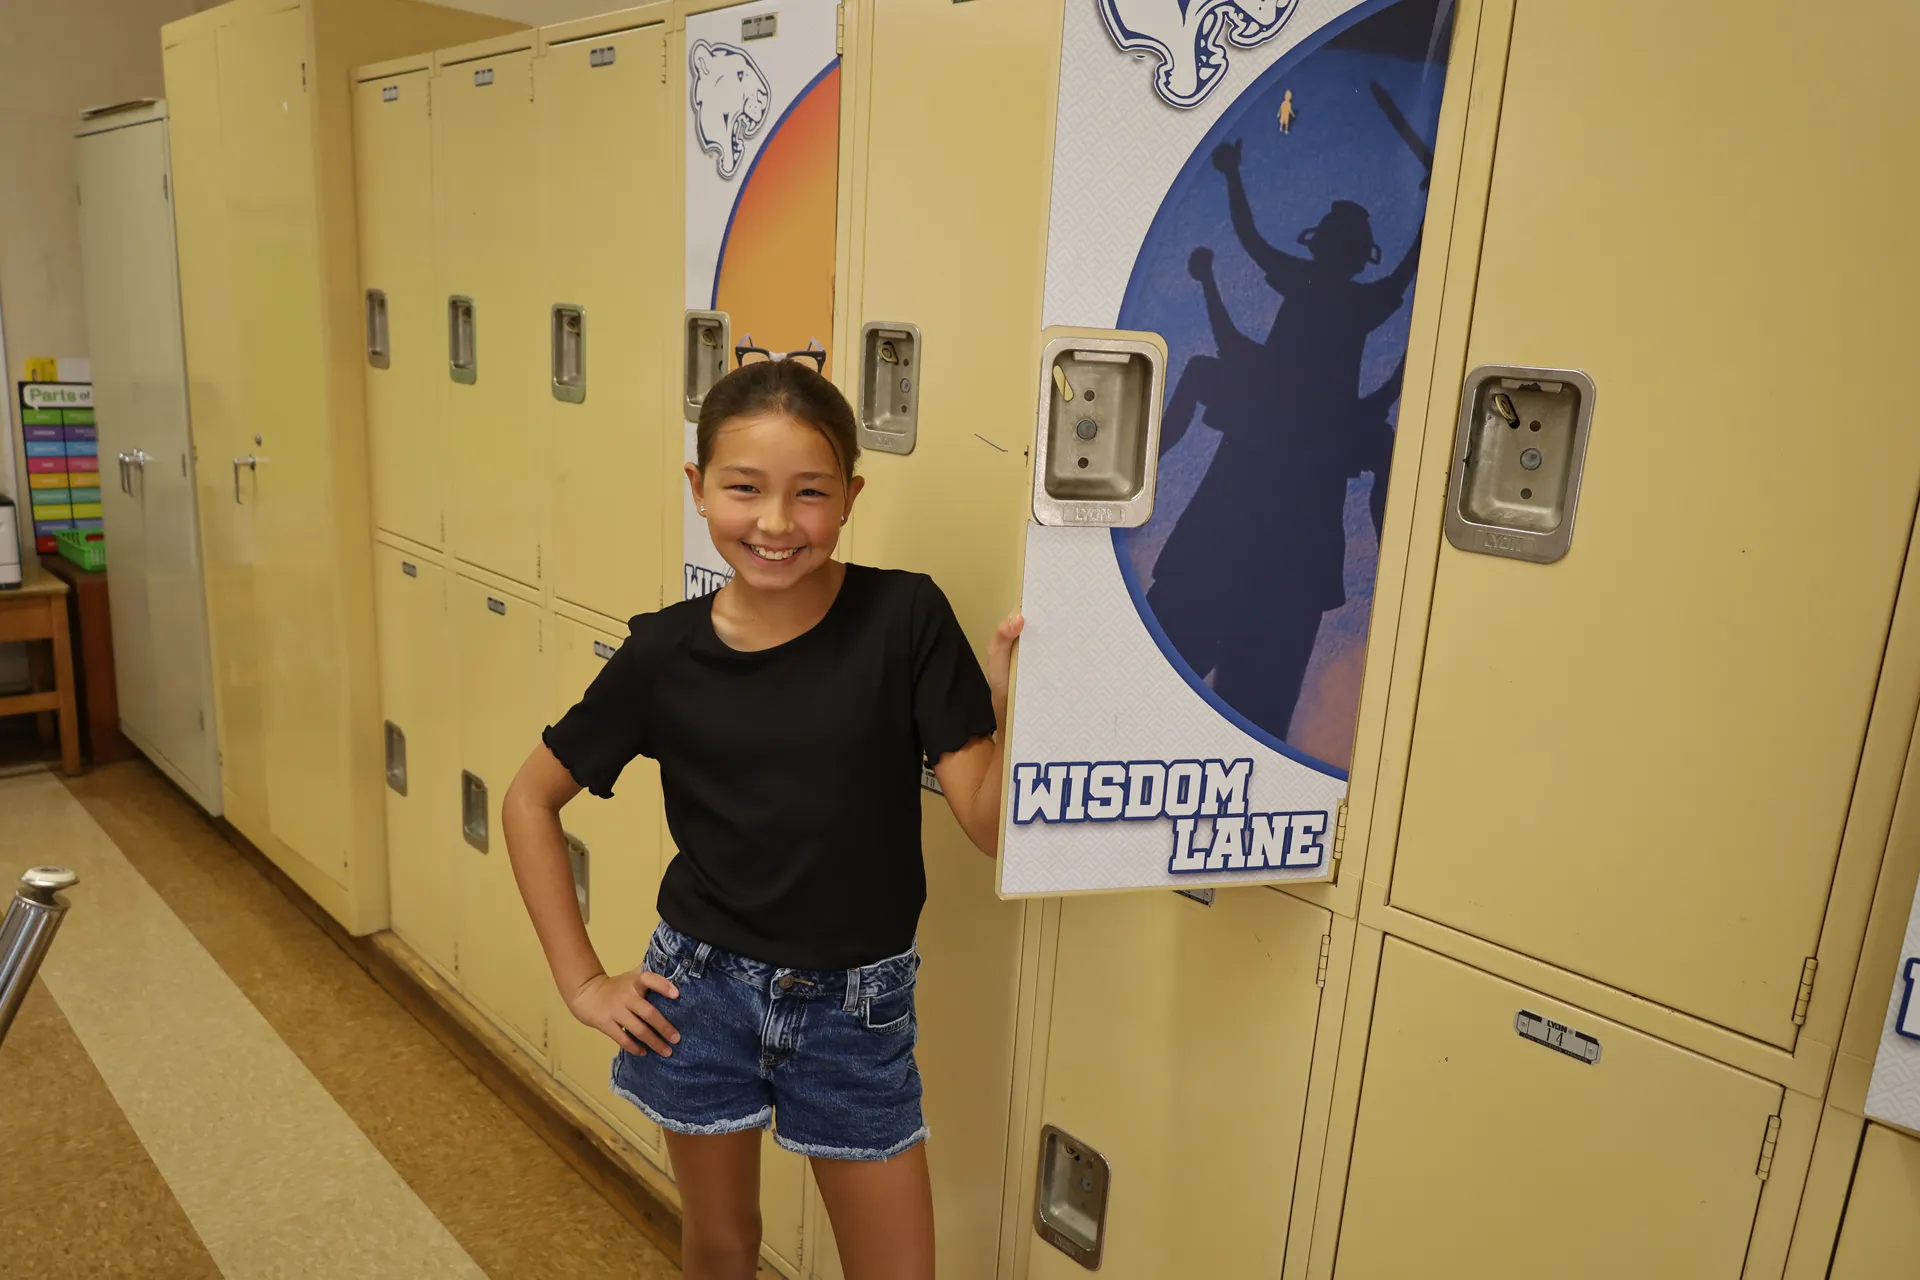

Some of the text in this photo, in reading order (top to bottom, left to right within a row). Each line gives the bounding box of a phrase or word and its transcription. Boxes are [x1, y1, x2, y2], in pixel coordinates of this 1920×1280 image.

[29, 387, 77, 403] Parts
[1014, 758, 1254, 824] WISDOM
[1168, 810, 1328, 874] LANE
[1547, 1020, 1568, 1033] LYON
